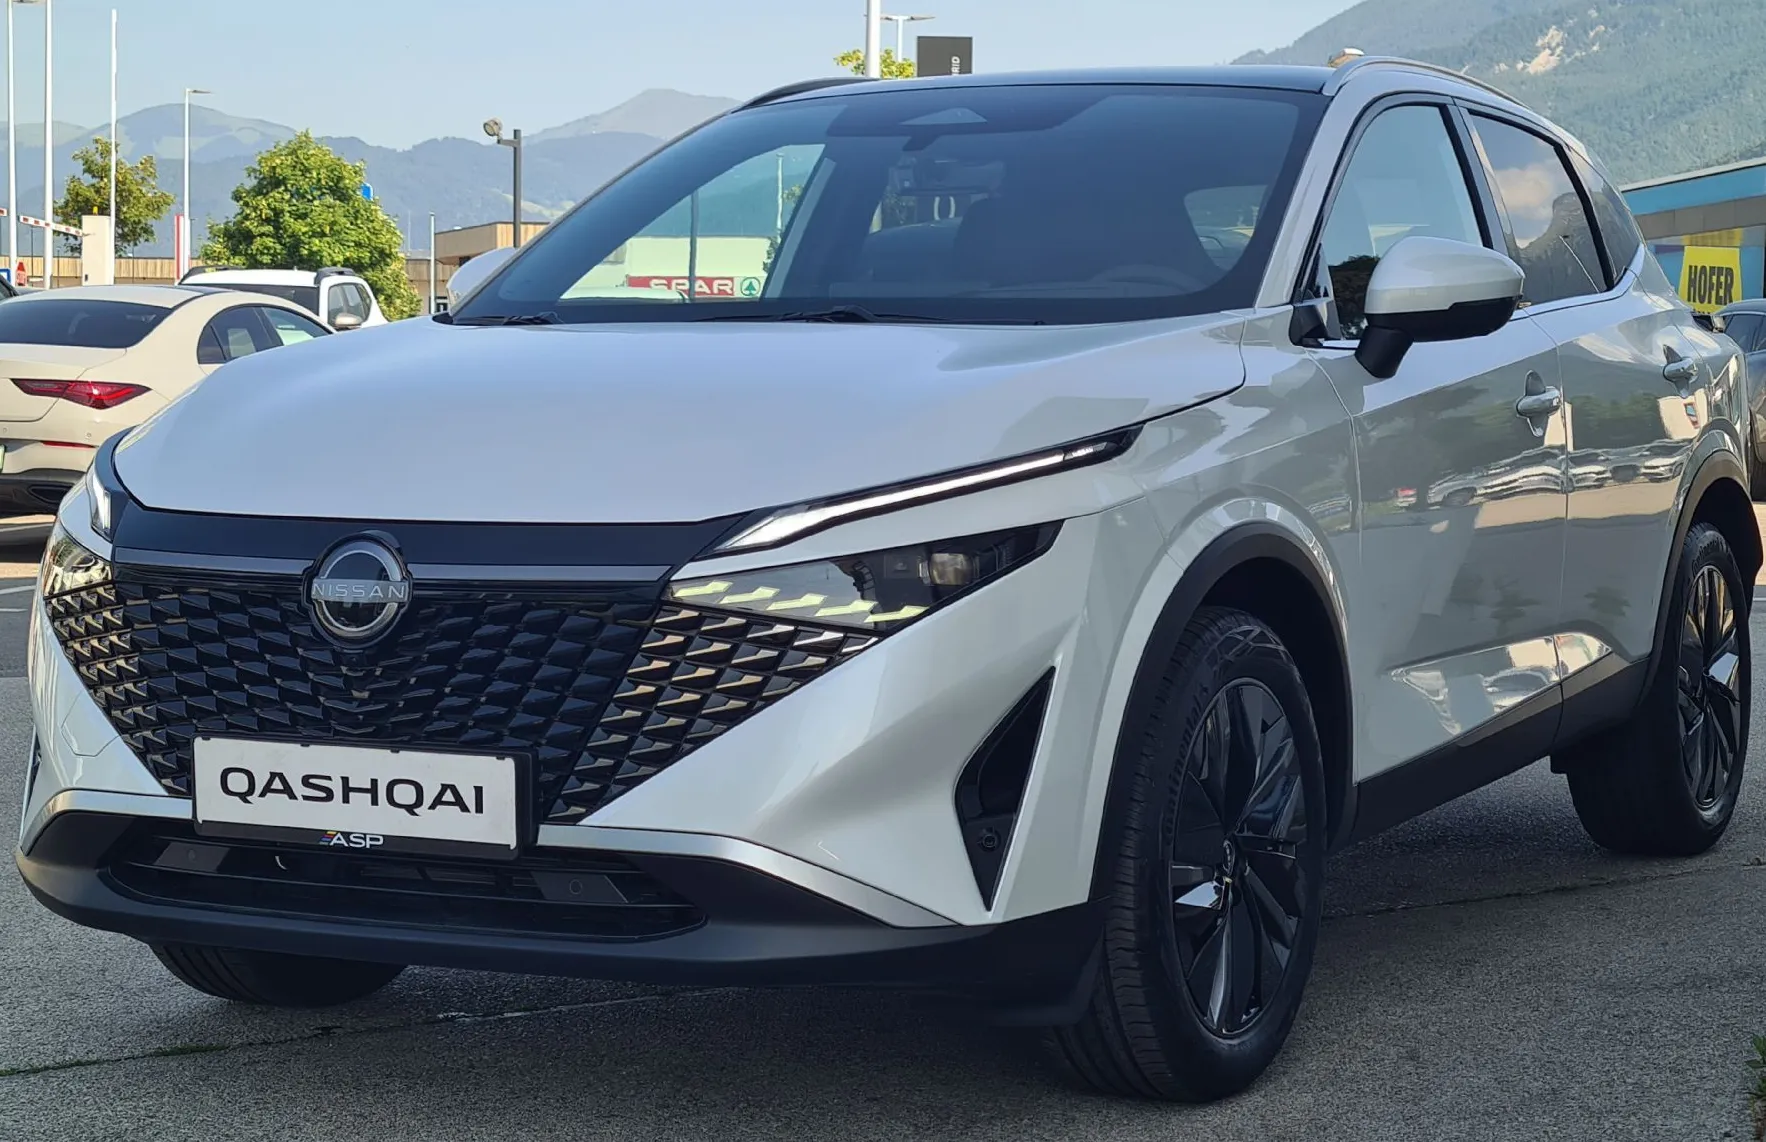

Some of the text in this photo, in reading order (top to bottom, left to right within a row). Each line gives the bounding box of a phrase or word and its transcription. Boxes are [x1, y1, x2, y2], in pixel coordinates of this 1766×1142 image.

[1687, 265, 1734, 306] HOFER
[312, 583, 405, 599] NISSAN
[220, 767, 484, 816] QASHQAI
[329, 832, 384, 849] ASP
